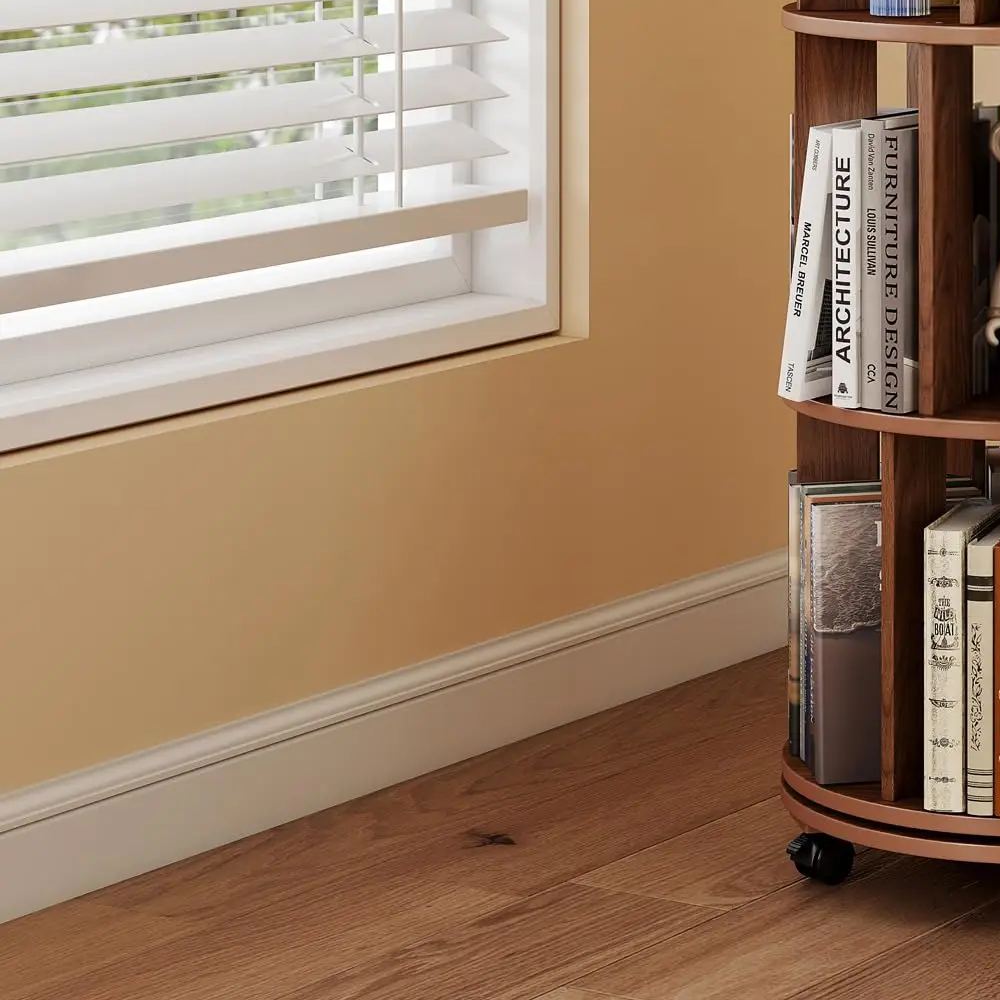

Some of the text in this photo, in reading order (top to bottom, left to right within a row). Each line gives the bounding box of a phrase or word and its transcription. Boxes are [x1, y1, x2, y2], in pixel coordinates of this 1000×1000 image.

[867, 133, 875, 190] David Van Zanten
[793, 221, 812, 317] MARCEL BREUER
[835, 156, 851, 364] ARCHITECTURE
[866, 208, 876, 276] LOUIS SULLIVAN
[884, 135, 899, 410] FURNITURE DESIGN
